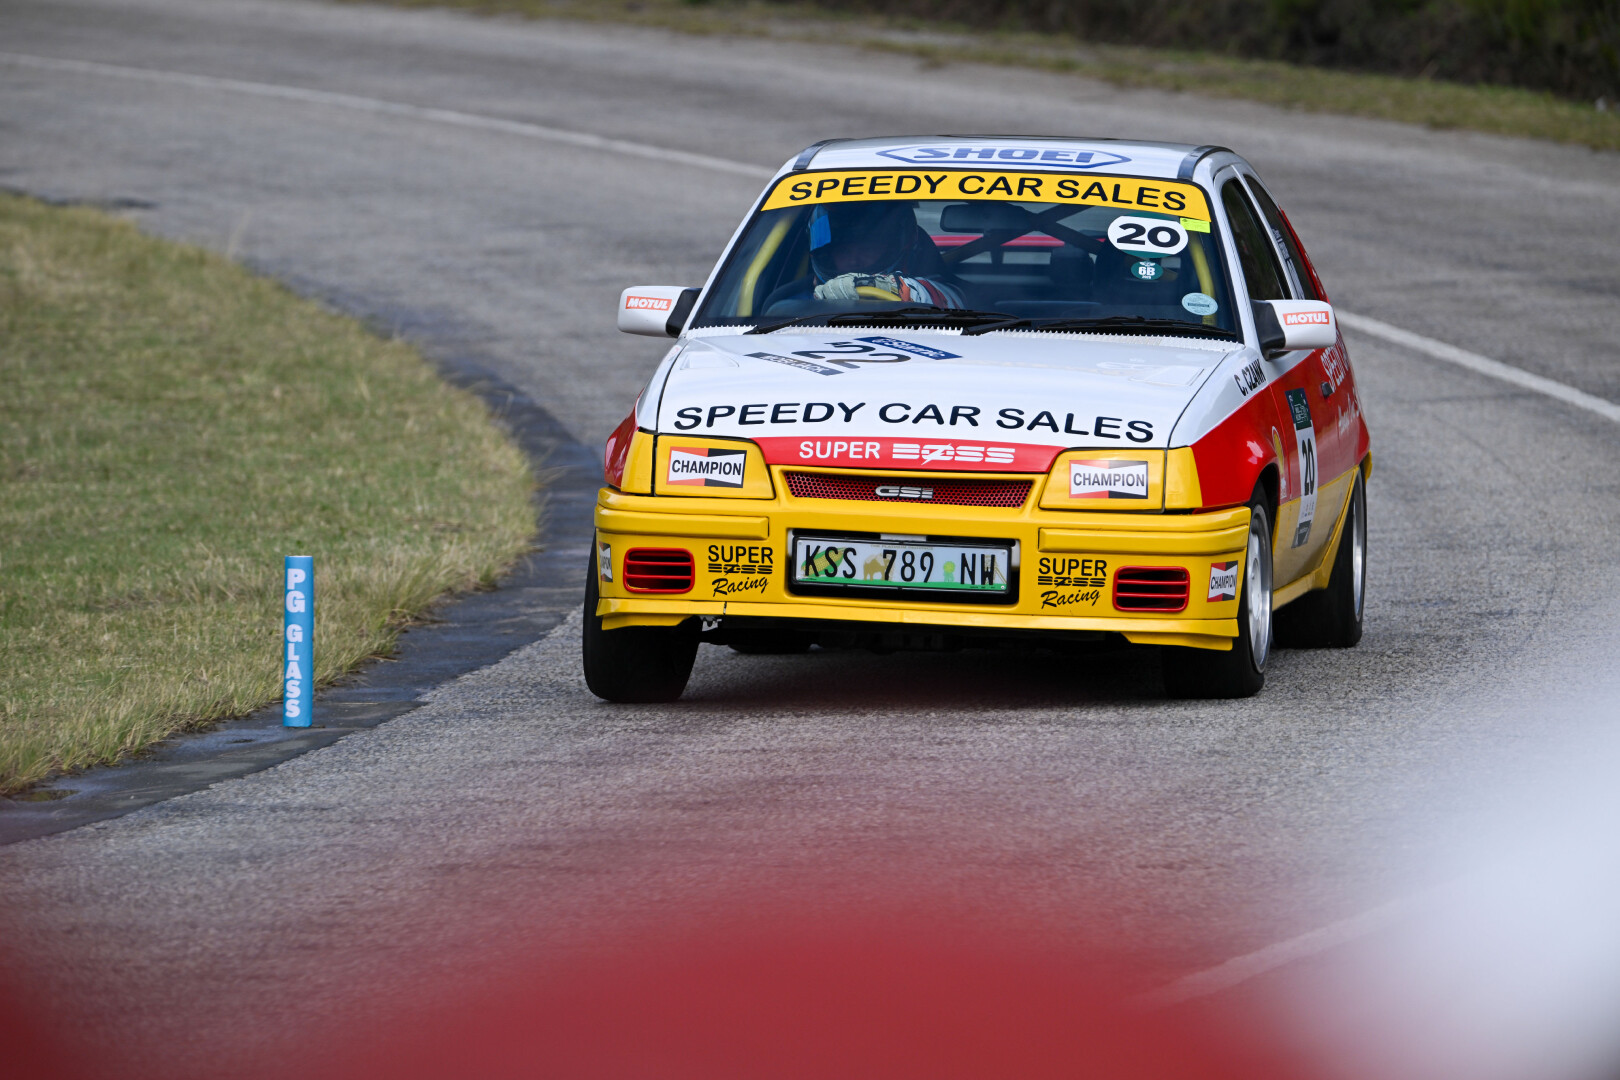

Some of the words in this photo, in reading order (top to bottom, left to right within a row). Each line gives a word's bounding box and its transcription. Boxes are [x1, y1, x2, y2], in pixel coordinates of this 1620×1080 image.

[914, 148, 1096, 164] SHOEI
[789, 174, 948, 201] SPEEDY
[958, 175, 1044, 197] CAR
[1055, 179, 1186, 211] SALES
[1116, 222, 1181, 248] 20
[1138, 266, 1156, 277] 6B
[627, 298, 668, 310] MOTUL
[1286, 312, 1328, 325] MOTUL
[674, 402, 866, 430] SPEEDY
[878, 402, 981, 427] CAR
[996, 408, 1154, 443] SALES
[799, 441, 881, 459] SUPER
[671, 459, 742, 476] CHAMPION
[1301, 437, 1316, 496] 20
[1073, 472, 1145, 487] CHAMPION
[708, 545, 774, 564] SUPER
[805, 545, 857, 579] KSS
[882, 549, 934, 583] 789
[960, 553, 996, 586] NW
[1038, 557, 1107, 577] SUPER
[285, 568, 306, 613] PG
[711, 577, 769, 597] Racing
[1211, 574, 1236, 590] CHAMPION
[1040, 589, 1100, 609] Racing
[285, 624, 303, 718] GLASS
